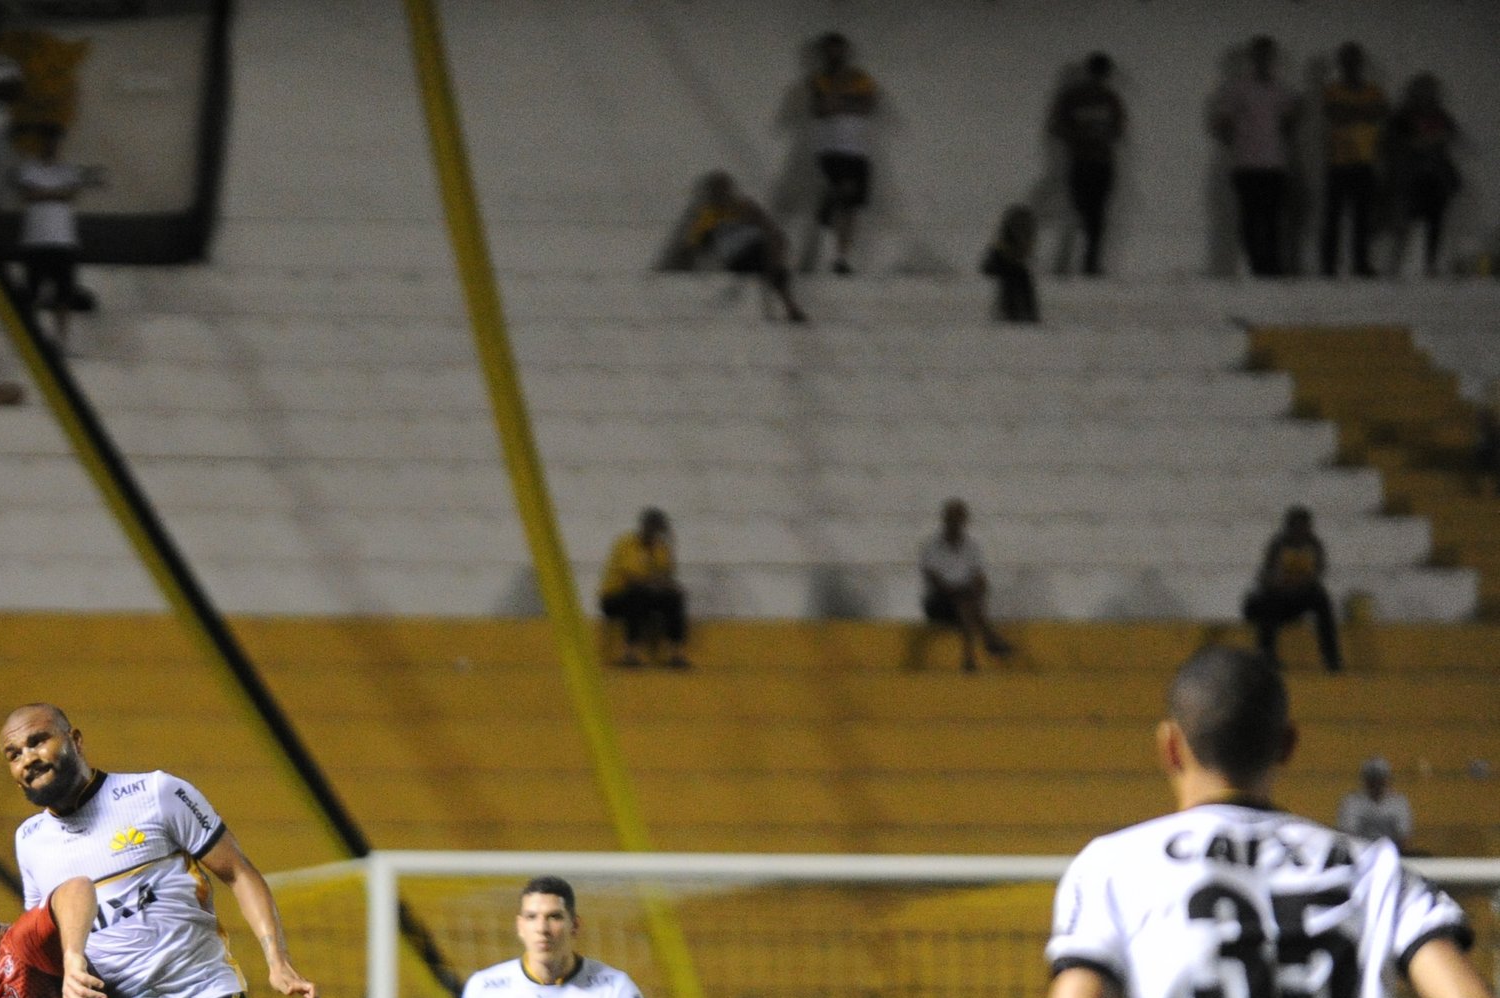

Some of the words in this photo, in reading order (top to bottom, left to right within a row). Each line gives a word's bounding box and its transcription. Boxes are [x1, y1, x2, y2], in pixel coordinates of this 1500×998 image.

[112, 779, 148, 801] SAINT
[1165, 829, 1354, 868] CAIXA
[91, 883, 159, 933] IXA
